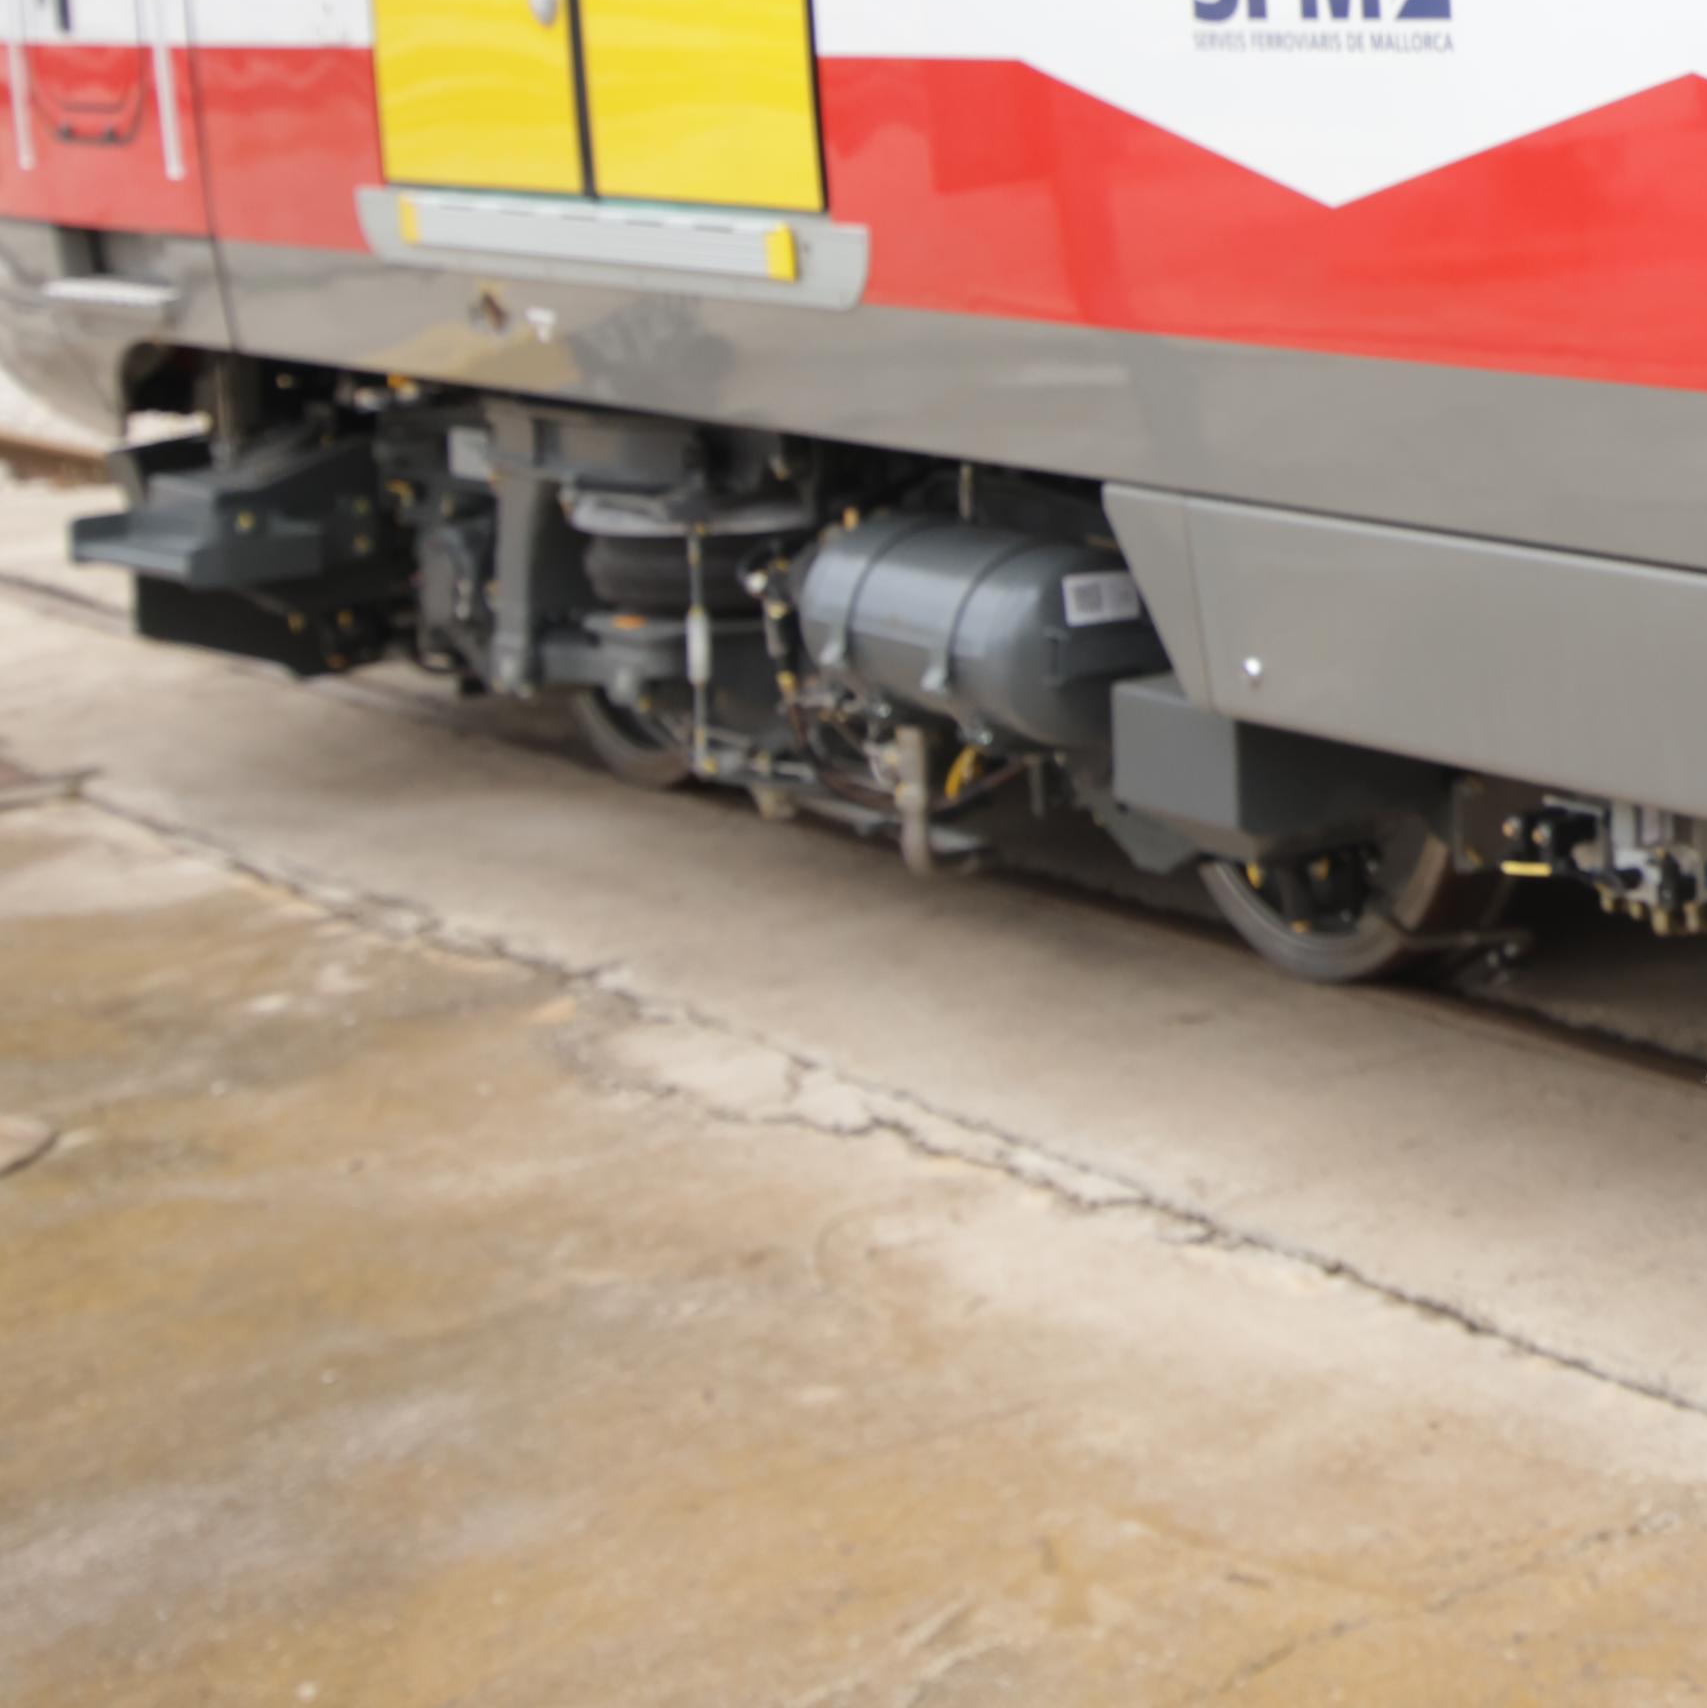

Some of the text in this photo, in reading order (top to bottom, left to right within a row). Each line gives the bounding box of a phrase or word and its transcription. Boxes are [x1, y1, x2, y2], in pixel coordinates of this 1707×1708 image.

[1192, 30, 1455, 54] SERVEIS FERROVIARIS DE MALLORCA
